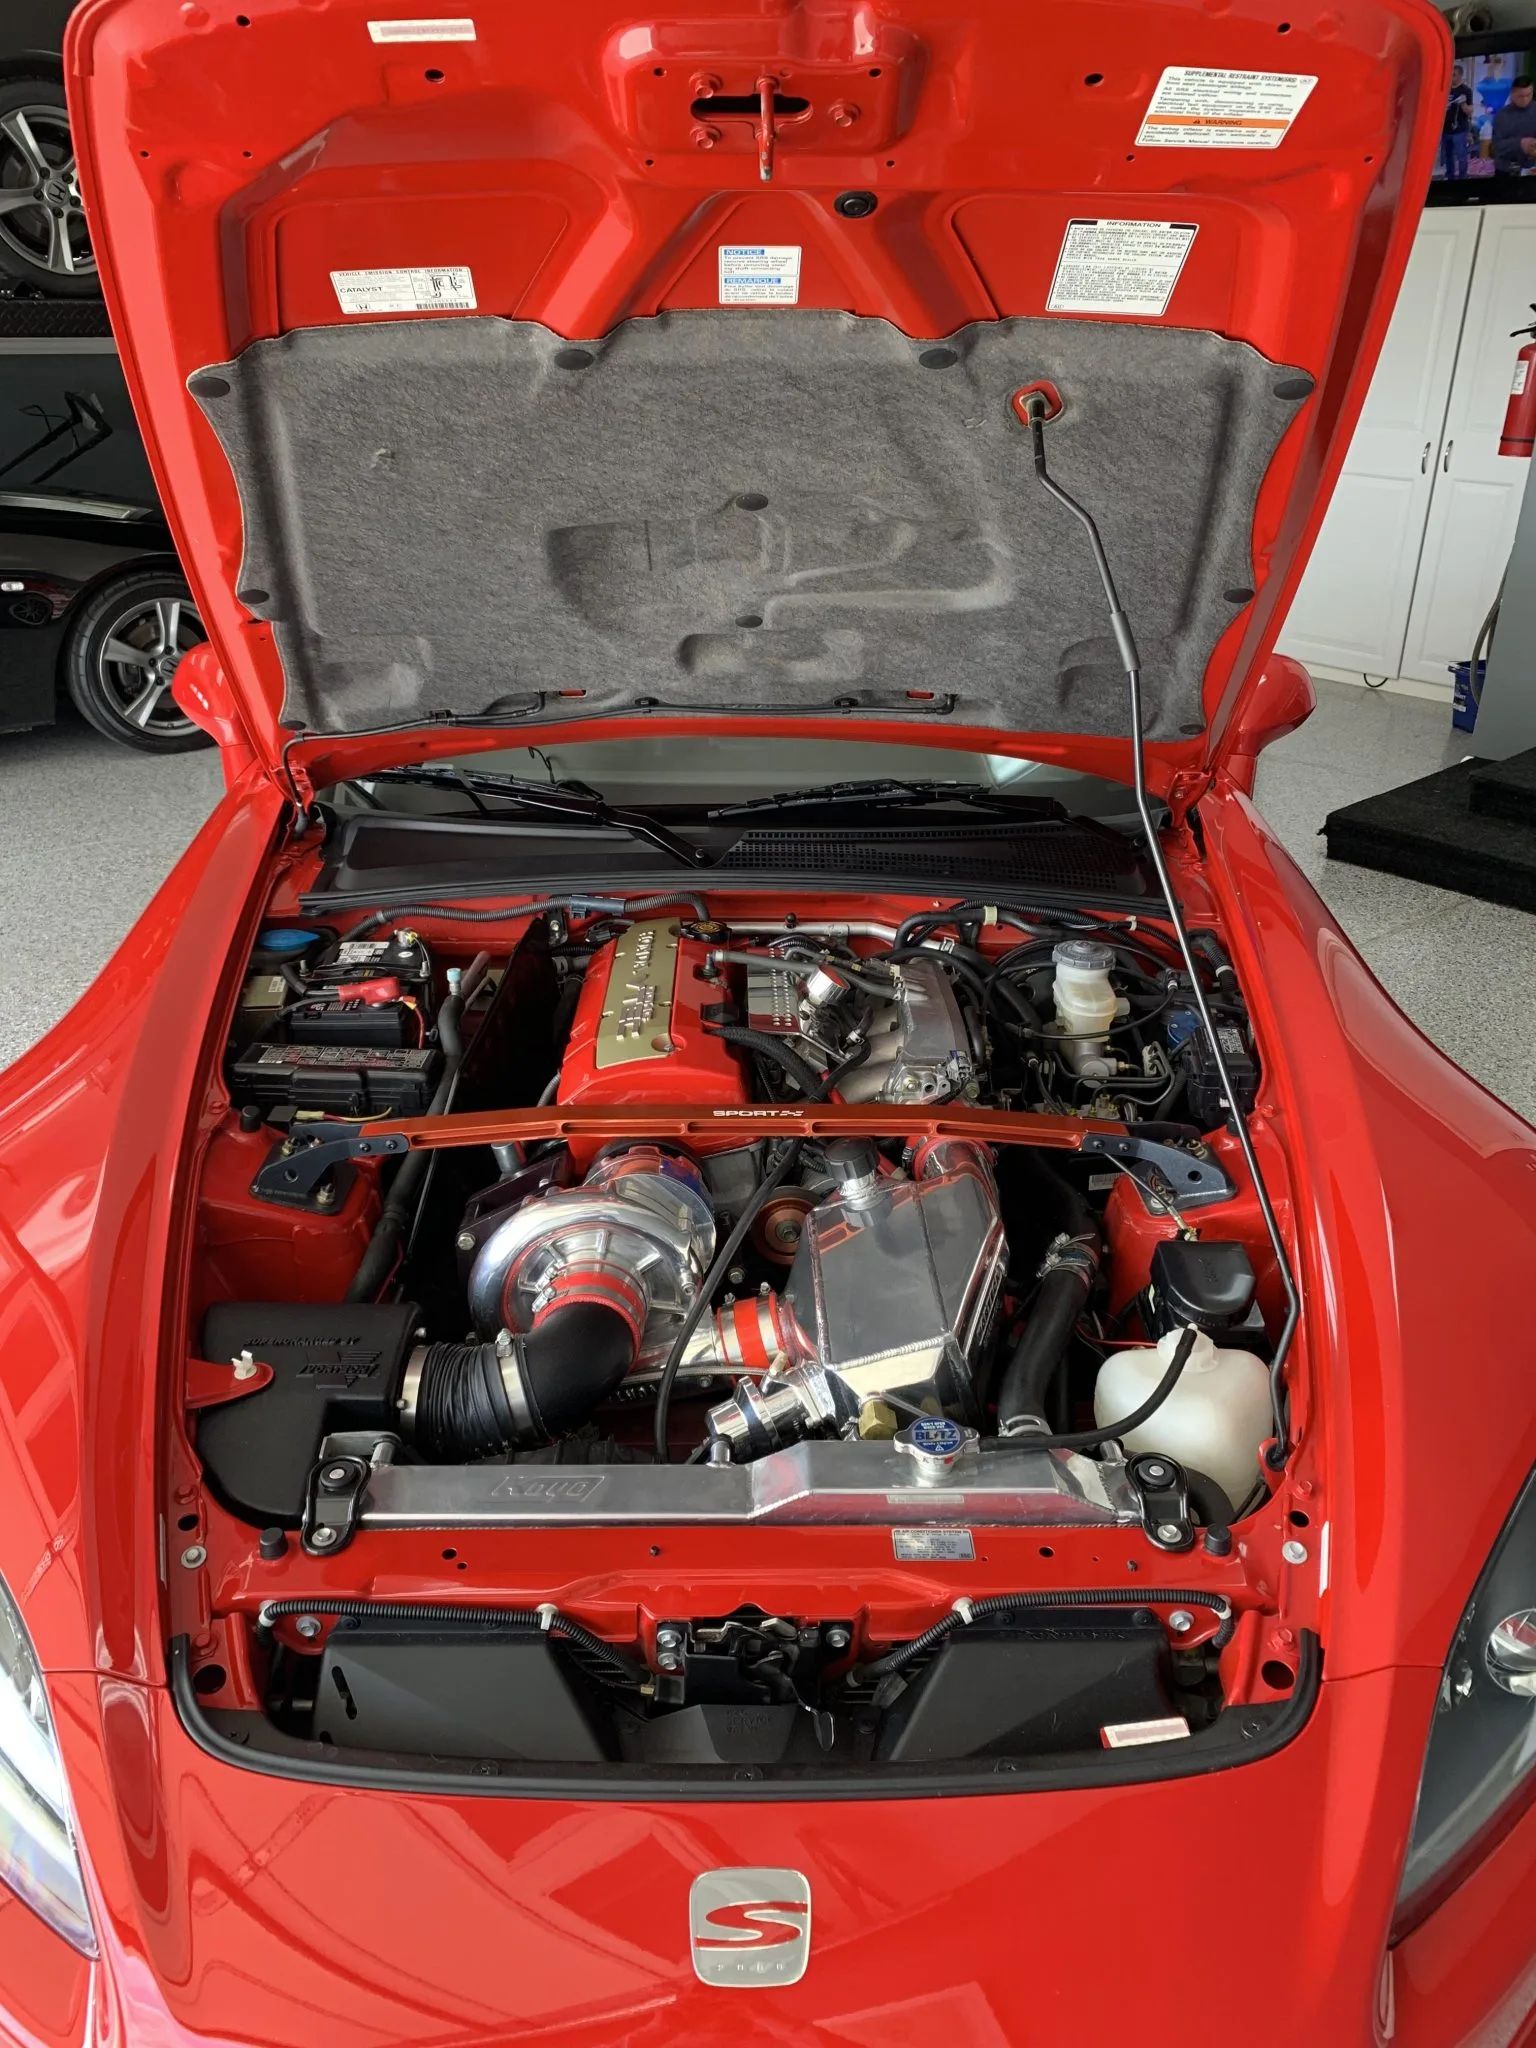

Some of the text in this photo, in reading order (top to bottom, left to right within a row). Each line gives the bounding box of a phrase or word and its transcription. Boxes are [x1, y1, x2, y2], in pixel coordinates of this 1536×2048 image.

[1183, 69, 1227, 78] SUPPLEMENTAL
[1106, 220, 1161, 228] INFORMATION
[915, 1429, 957, 1441] BLITZ
